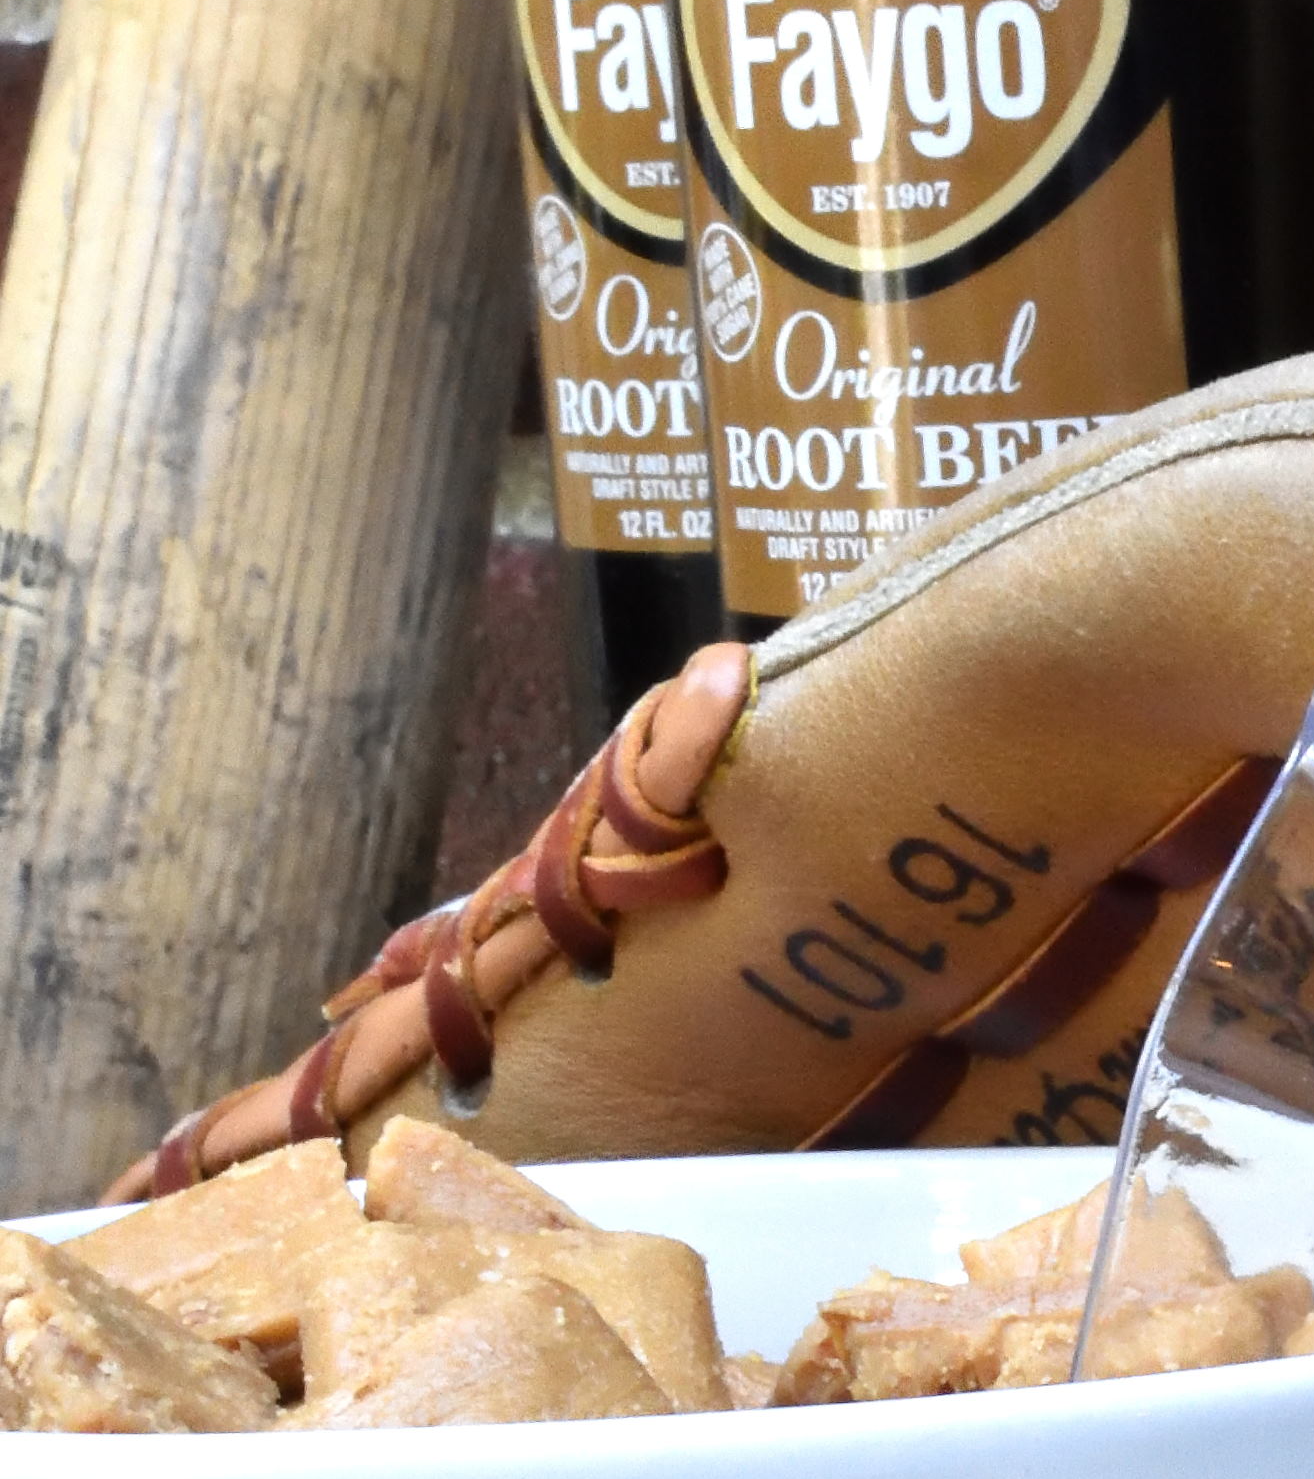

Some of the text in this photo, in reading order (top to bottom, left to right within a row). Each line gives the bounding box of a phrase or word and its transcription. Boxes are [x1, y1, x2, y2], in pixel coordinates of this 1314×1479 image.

[811, 182, 951, 215] EST. 1907
[597, 274, 700, 379] Orig
[774, 301, 1037, 425] Original
[556, 379, 702, 437] ROOT
[724, 426, 895, 491] ROOT
[640, 478, 693, 501] STYLE
[618, 510, 643, 538] 12
[820, 510, 859, 533] AND
[768, 536, 818, 560] DRAFT
